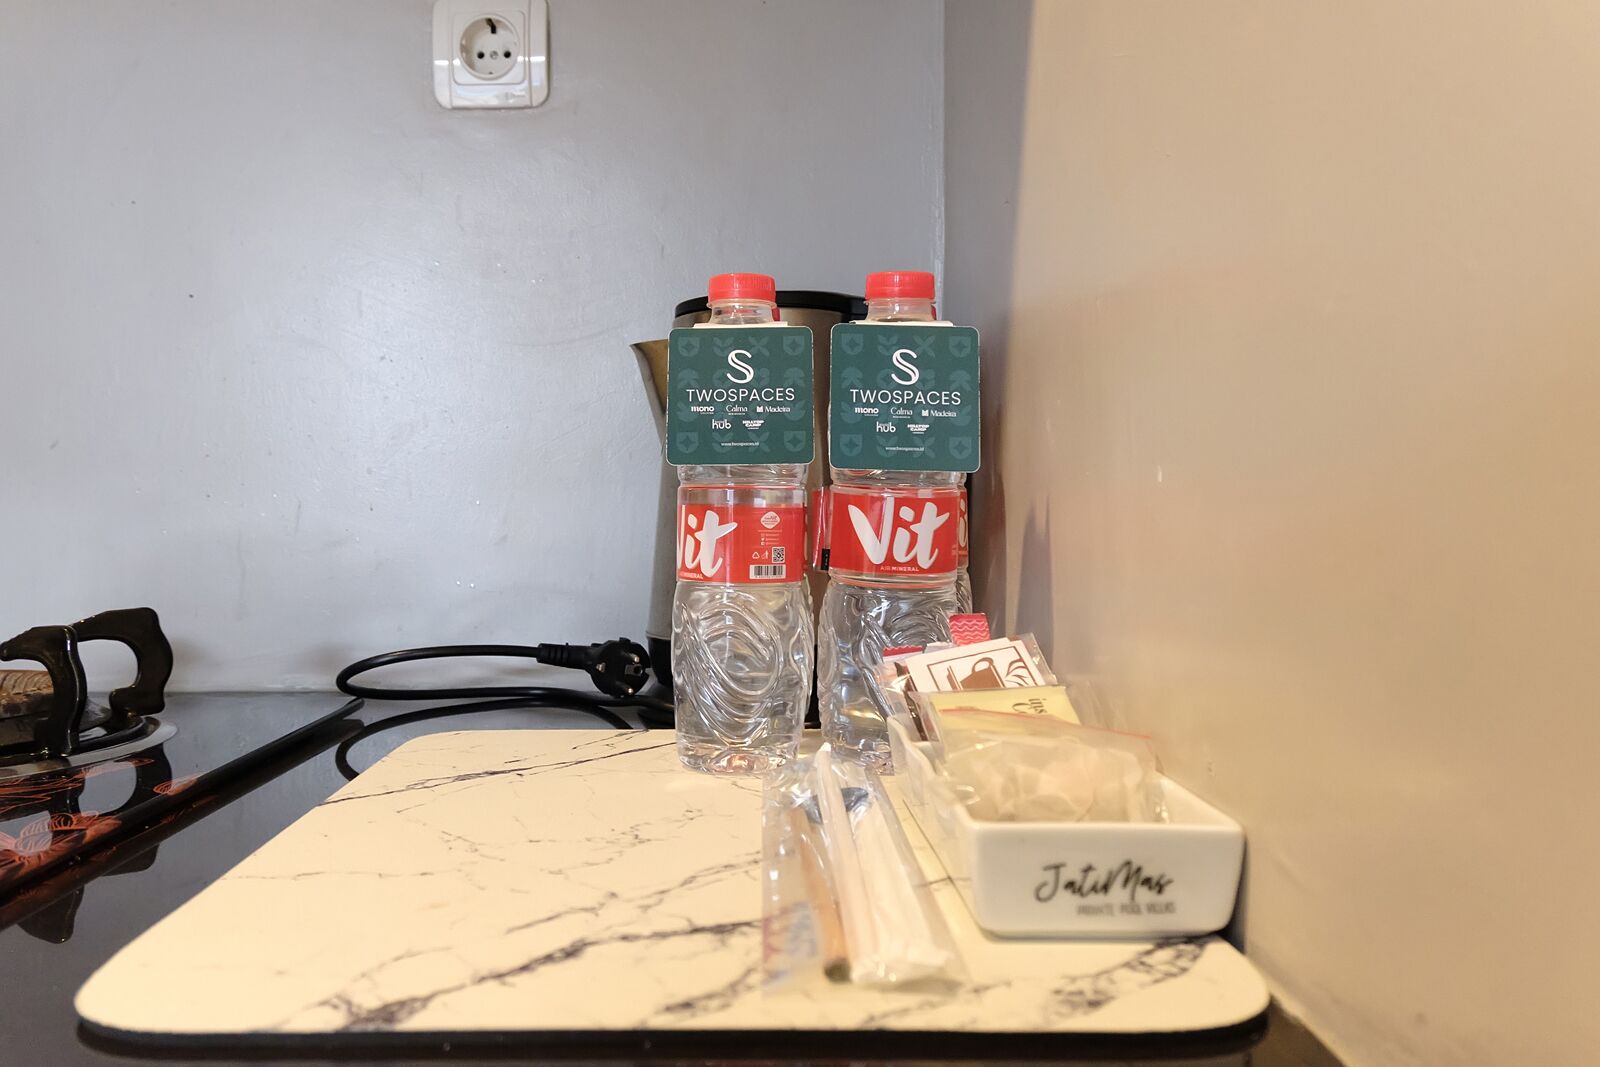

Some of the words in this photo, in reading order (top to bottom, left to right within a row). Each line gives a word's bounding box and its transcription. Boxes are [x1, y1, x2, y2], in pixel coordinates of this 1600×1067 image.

[686, 388, 796, 402] TWOSPACES
[850, 389, 961, 405] TWOSPACES
[725, 404, 748, 413] Calma
[764, 405, 791, 413] Madeira
[890, 407, 913, 416] Calma
[930, 410, 957, 418] Madeira
[712, 418, 732, 430] hub
[876, 421, 897, 433] hub
[847, 496, 950, 570] Vit
